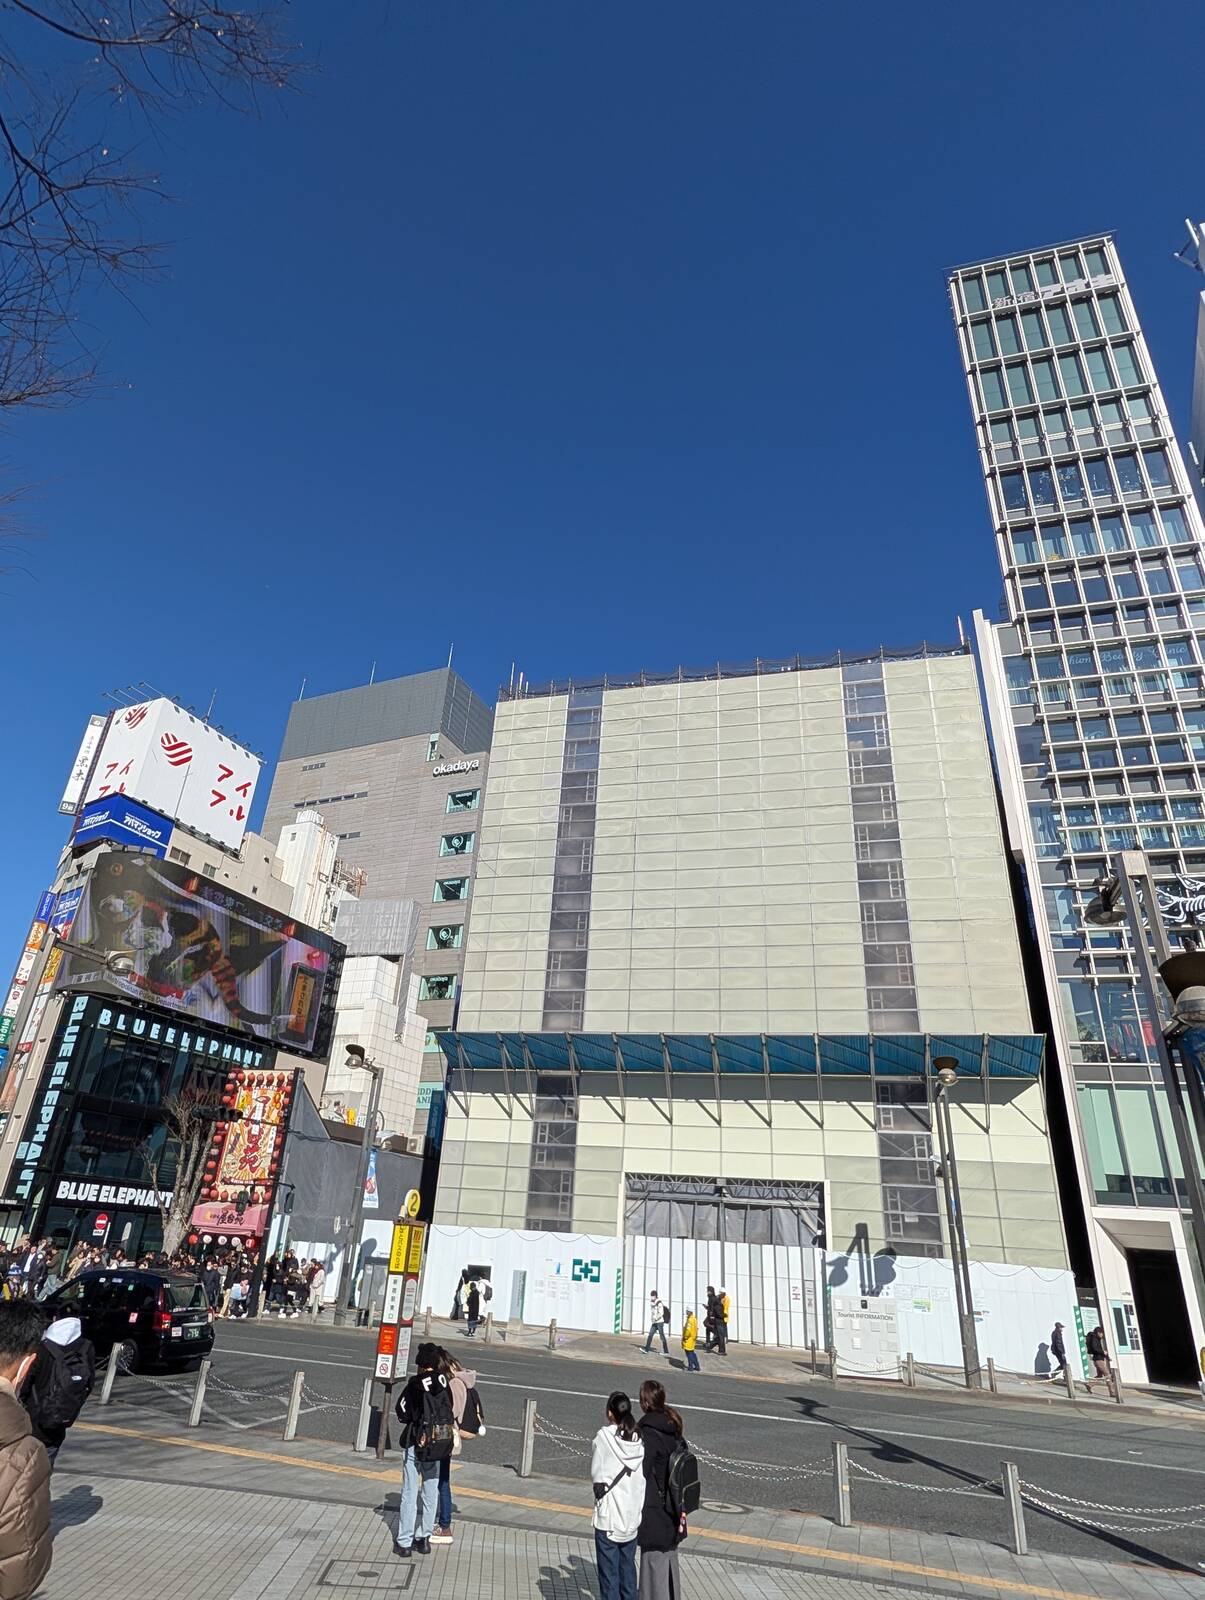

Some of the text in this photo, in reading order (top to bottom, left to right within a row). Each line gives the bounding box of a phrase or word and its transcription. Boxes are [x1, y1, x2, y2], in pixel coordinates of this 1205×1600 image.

[433, 759, 479, 774] okadaya
[217, 764, 252, 797] アイ
[209, 789, 246, 822] フル
[123, 815, 162, 839] アパマンショップ
[99, 1008, 263, 1068] BLUE ELEPHANT
[16, 996, 89, 1199] BLUE ELEPHANT
[56, 1181, 174, 1208] BLUE ELEPHANT
[410, 1193, 418, 1212] 2
[855, 1313, 894, 1321] INFORMATION
